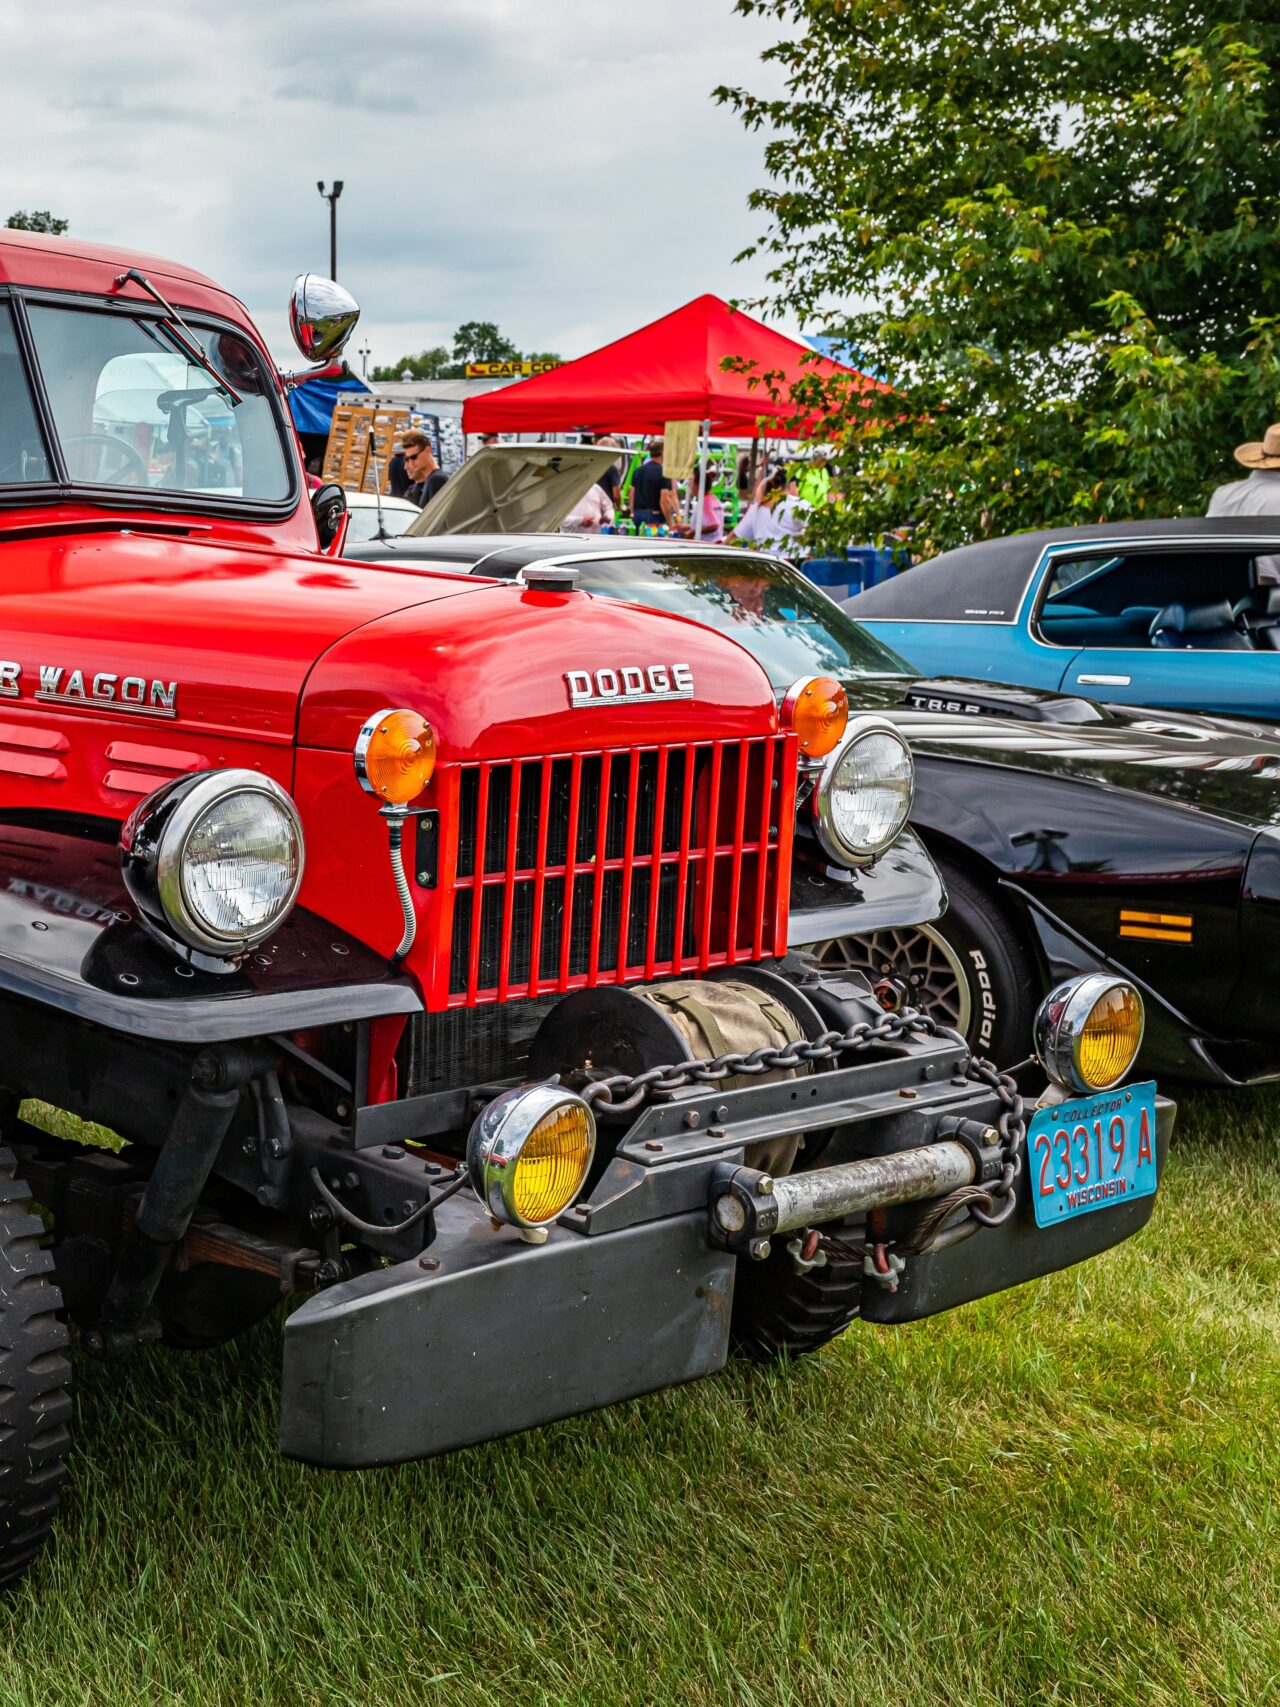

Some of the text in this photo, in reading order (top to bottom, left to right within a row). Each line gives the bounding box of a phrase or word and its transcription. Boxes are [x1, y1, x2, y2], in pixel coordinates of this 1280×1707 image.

[488, 364, 522, 374] CAR
[37, 665, 178, 711] WAGON
[562, 663, 694, 699] DODGE
[968, 949, 996, 1049] Radial
[1063, 1098, 1123, 1124] COLLECTOR
[1034, 1106, 1153, 1197] 23319 A
[1065, 1176, 1127, 1210] WISCONSIN
